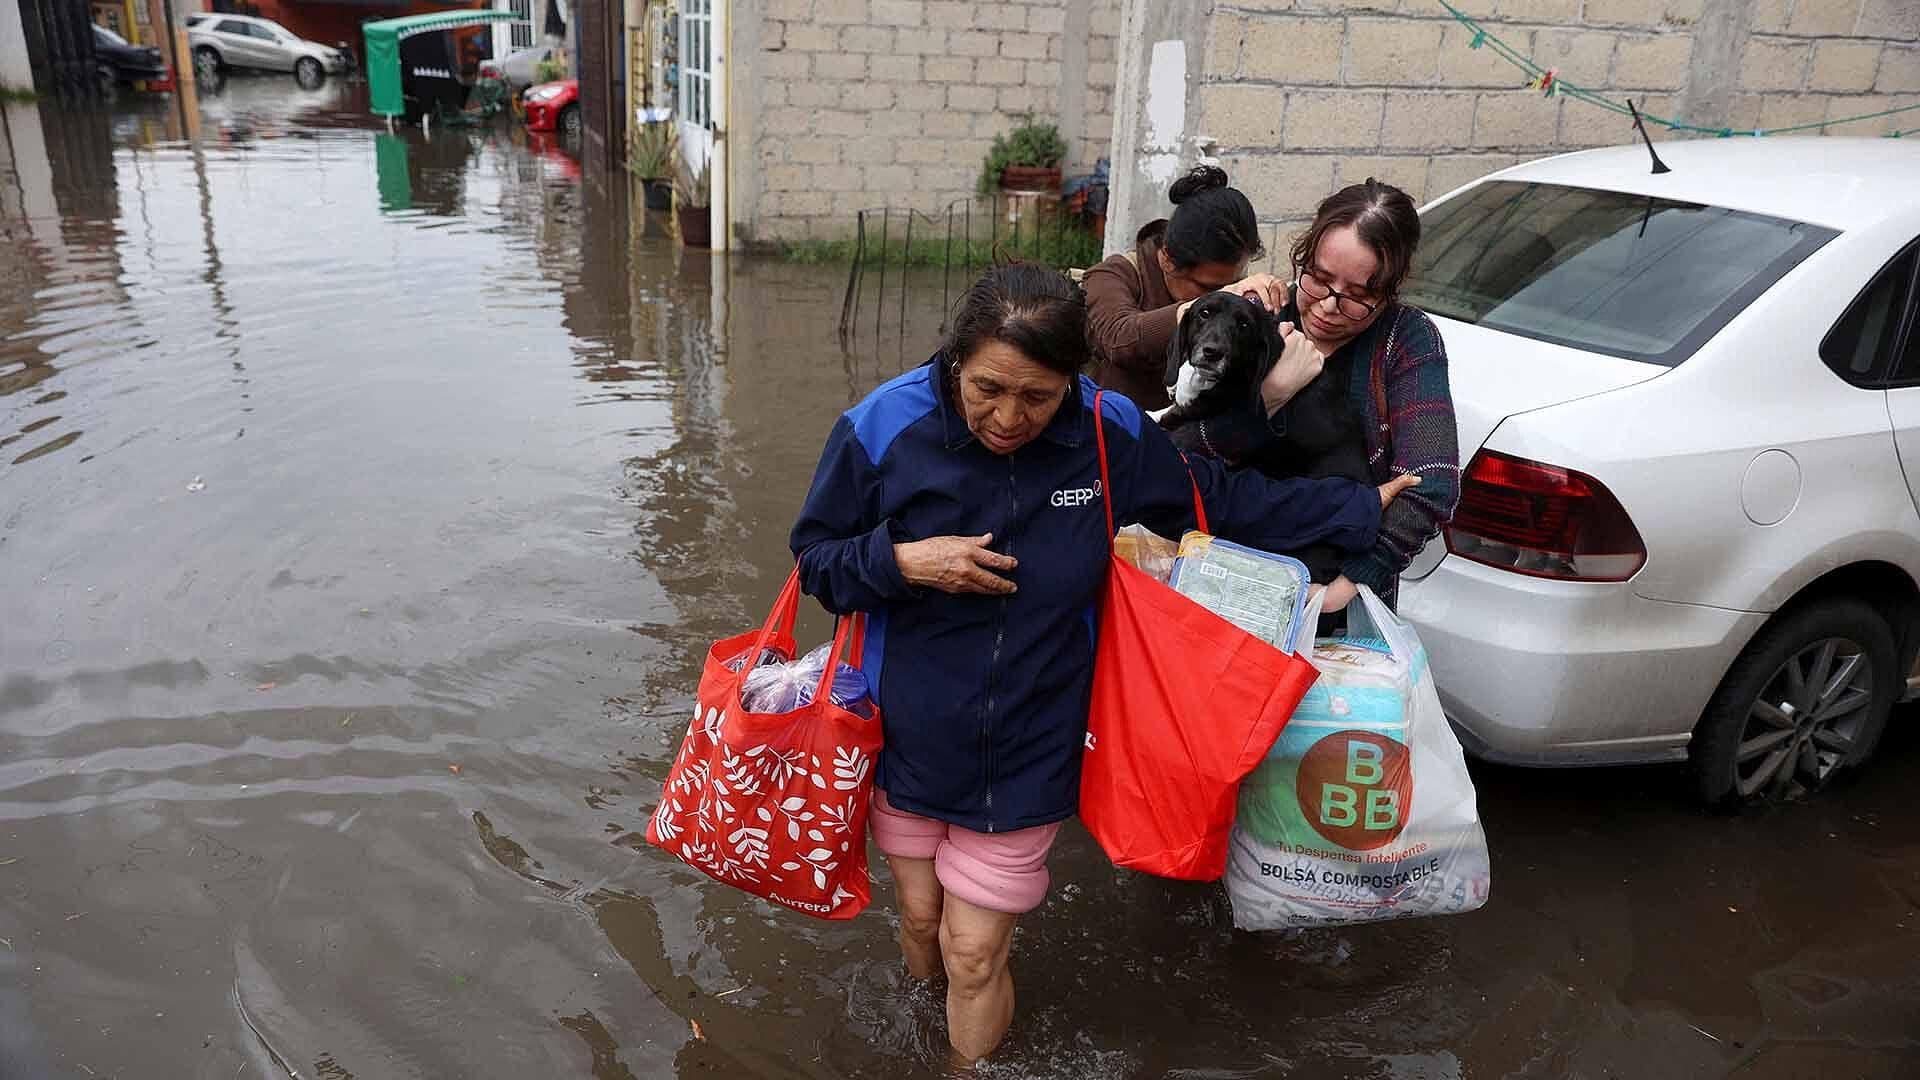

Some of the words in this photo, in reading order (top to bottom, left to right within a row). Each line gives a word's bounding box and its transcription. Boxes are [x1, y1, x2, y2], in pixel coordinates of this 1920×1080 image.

[1050, 488, 1095, 507] GEPP
[1346, 740, 1384, 785] B
[1320, 783, 1400, 830] BB
[1295, 844, 1362, 863] Despensa
[1260, 862, 1317, 884] BOLSA
[1322, 858, 1440, 889] COMPOSTABLE
[768, 892, 833, 913] Aurrera
